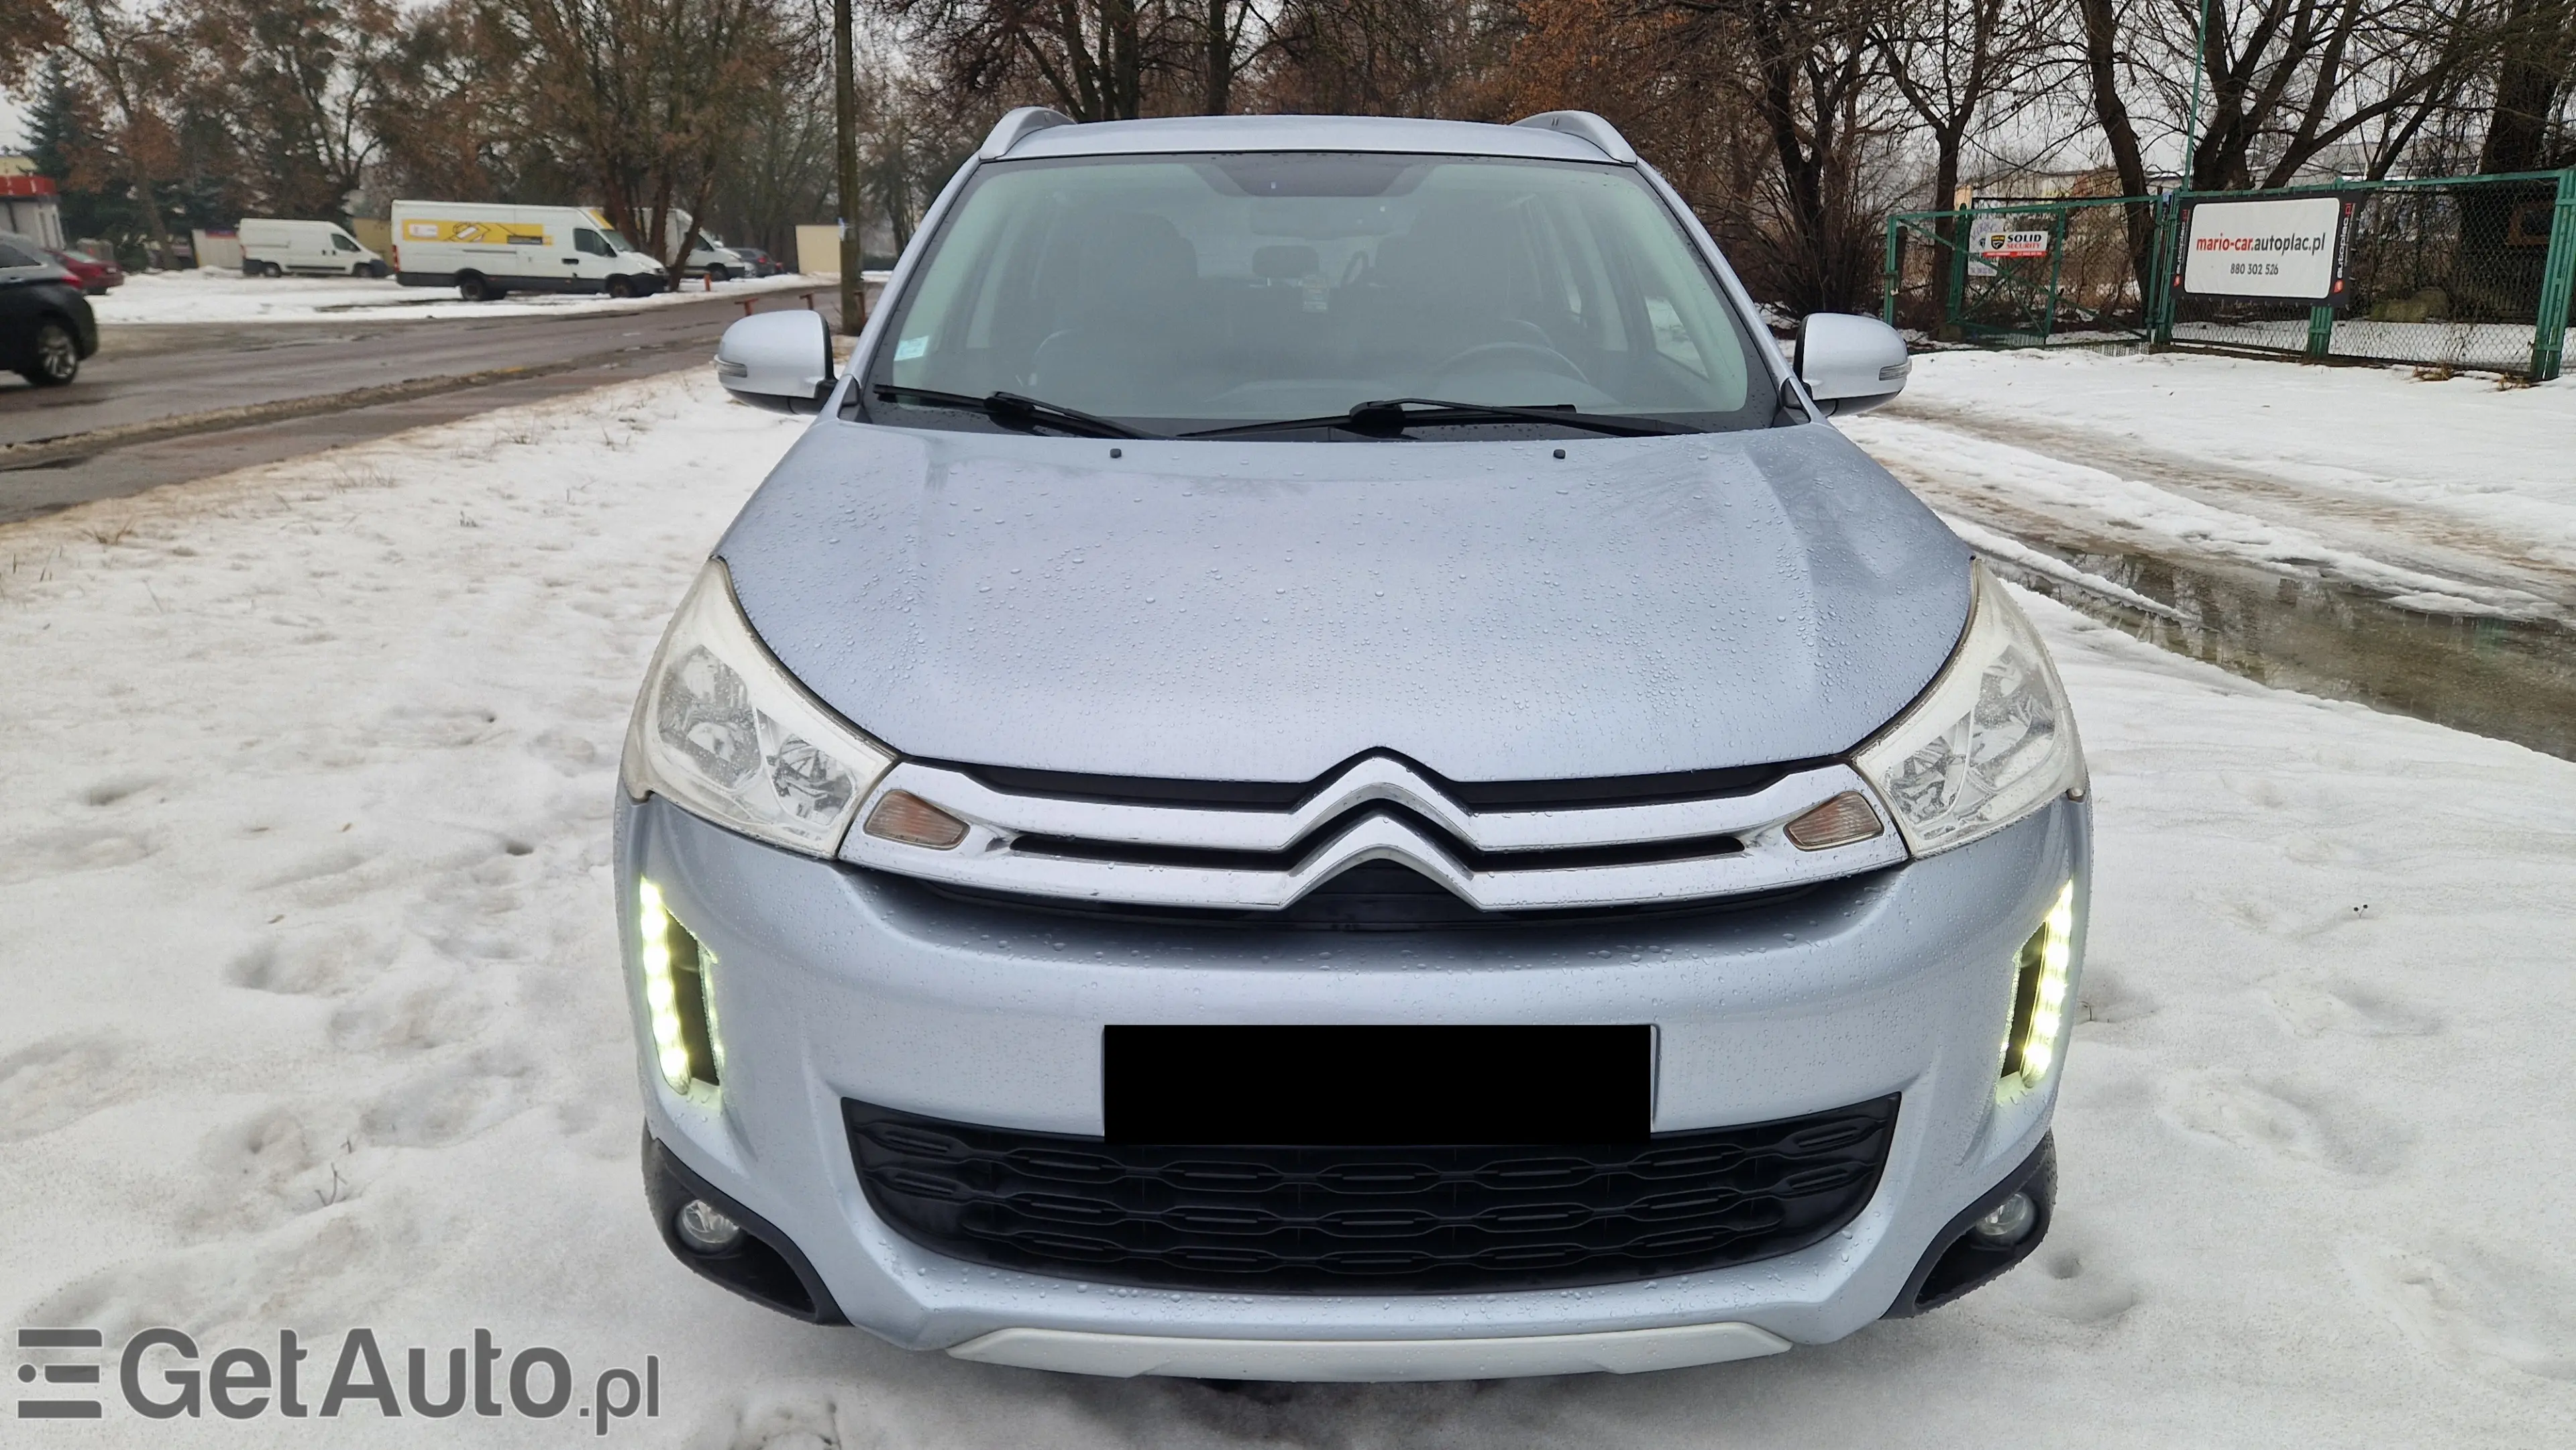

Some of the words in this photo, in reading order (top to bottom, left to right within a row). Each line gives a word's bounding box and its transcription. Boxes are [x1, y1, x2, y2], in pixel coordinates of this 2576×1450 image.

[2007, 234, 2042, 243] SOLID
[2196, 233, 2326, 256] mario-car.autoplac.pl
[2230, 263, 2245, 274] 880
[2247, 264, 2263, 275] 302
[2265, 264, 2279, 276] 526
